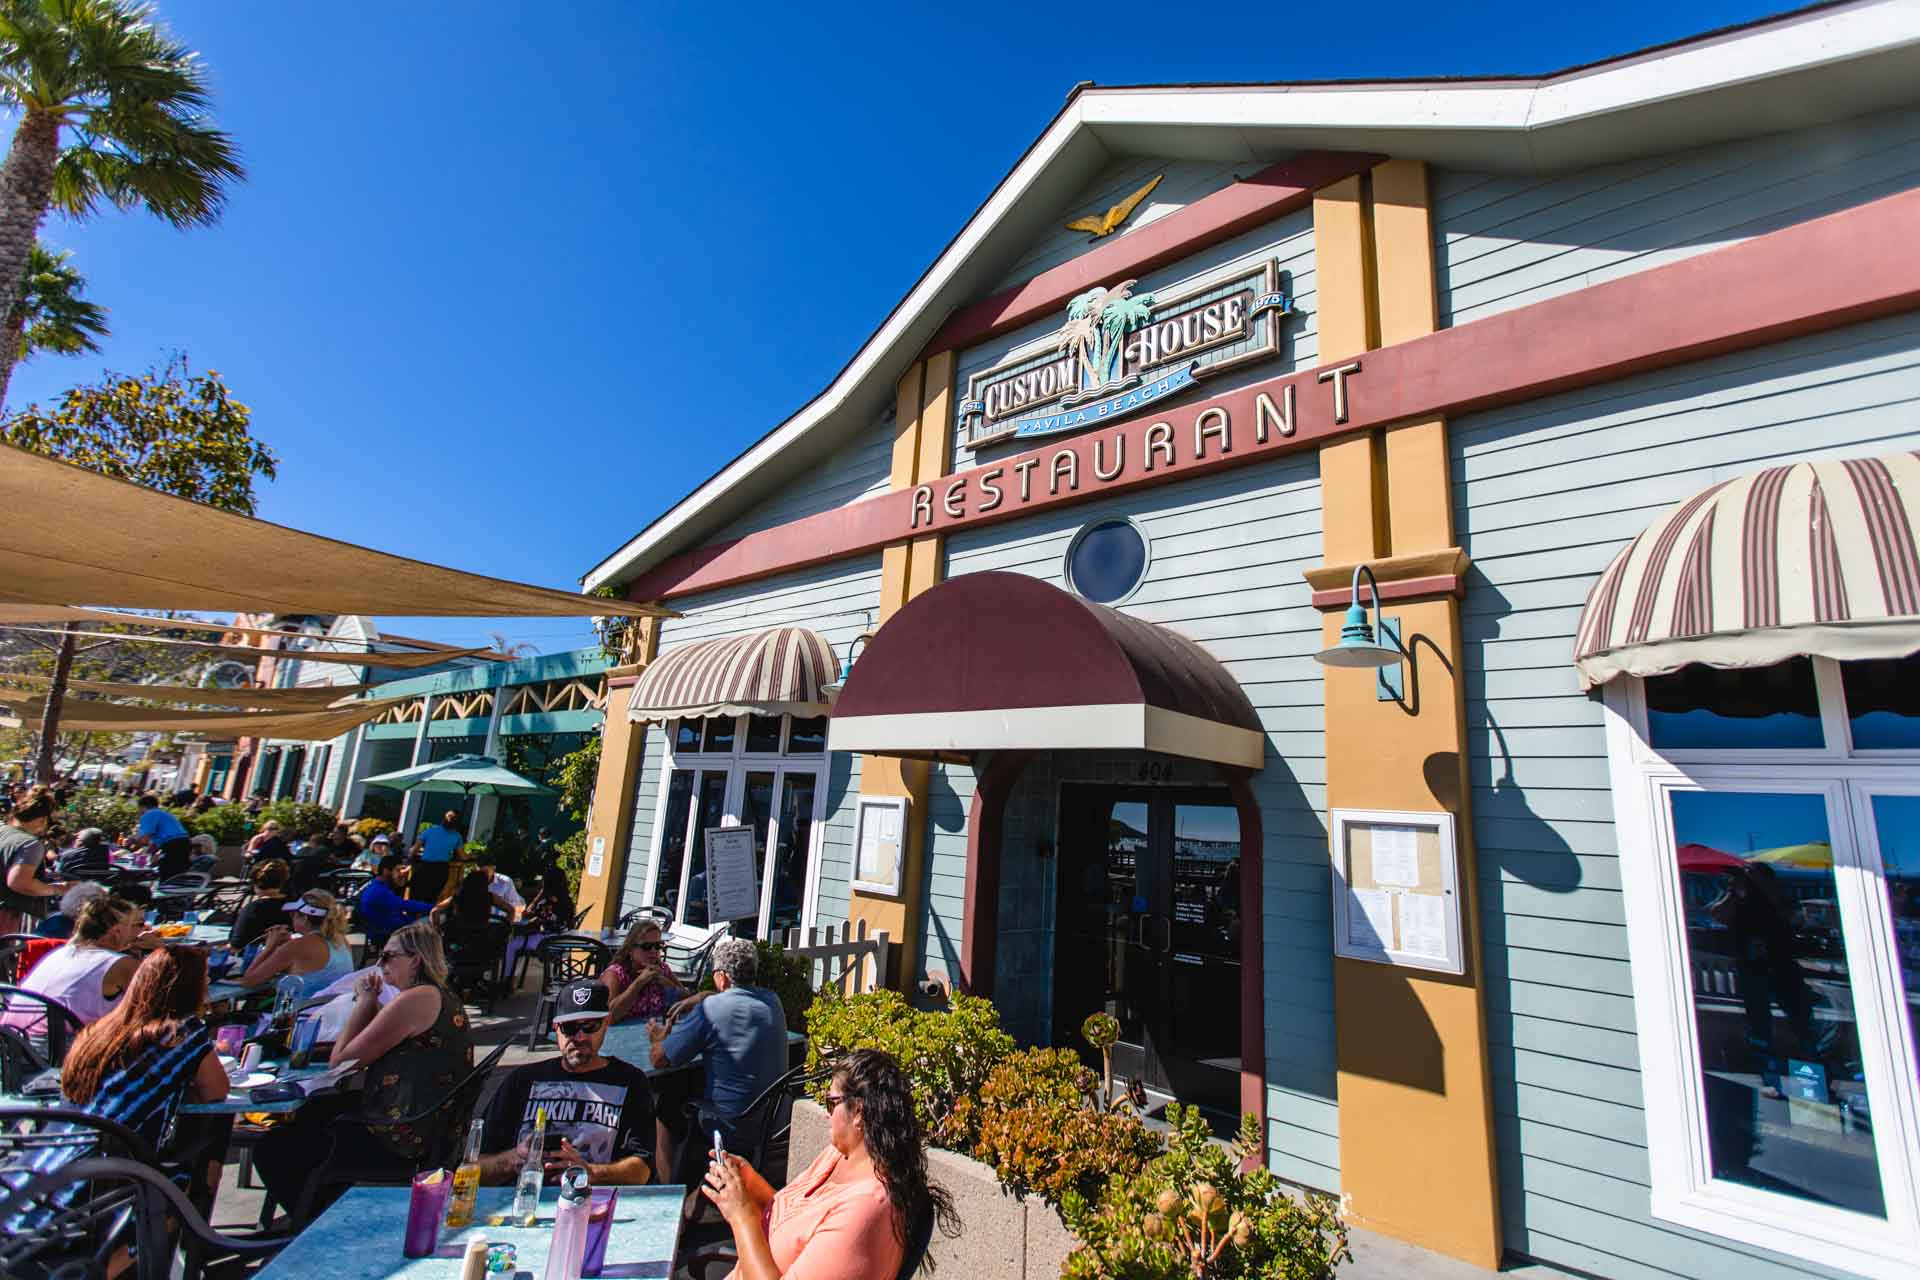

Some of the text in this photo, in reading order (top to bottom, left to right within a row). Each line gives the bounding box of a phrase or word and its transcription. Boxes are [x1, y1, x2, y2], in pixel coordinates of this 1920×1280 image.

[1252, 294, 1281, 309] 1975
[986, 296, 1245, 420] CUSTOM HOUSE
[1032, 381, 1170, 431] AVILA BEACH
[911, 361, 1362, 528] RESTAURANT
[1138, 760, 1173, 781] 404
